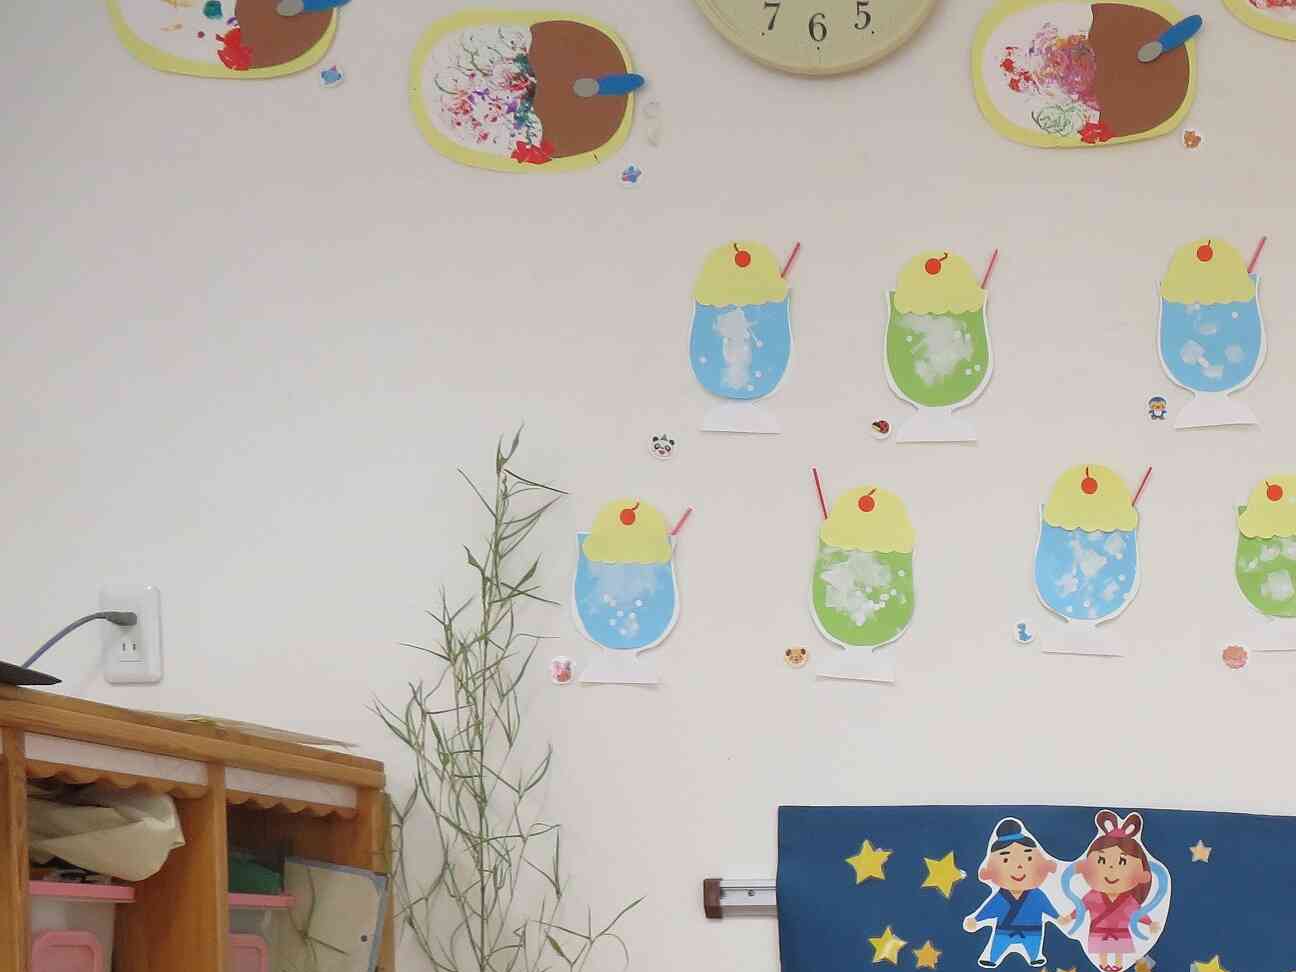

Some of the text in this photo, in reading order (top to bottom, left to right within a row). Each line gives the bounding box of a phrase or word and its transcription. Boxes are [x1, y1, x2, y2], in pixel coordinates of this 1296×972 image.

[763, 1, 781, 31] 7
[808, 12, 828, 42] 6
[854, 0, 872, 30] 5
